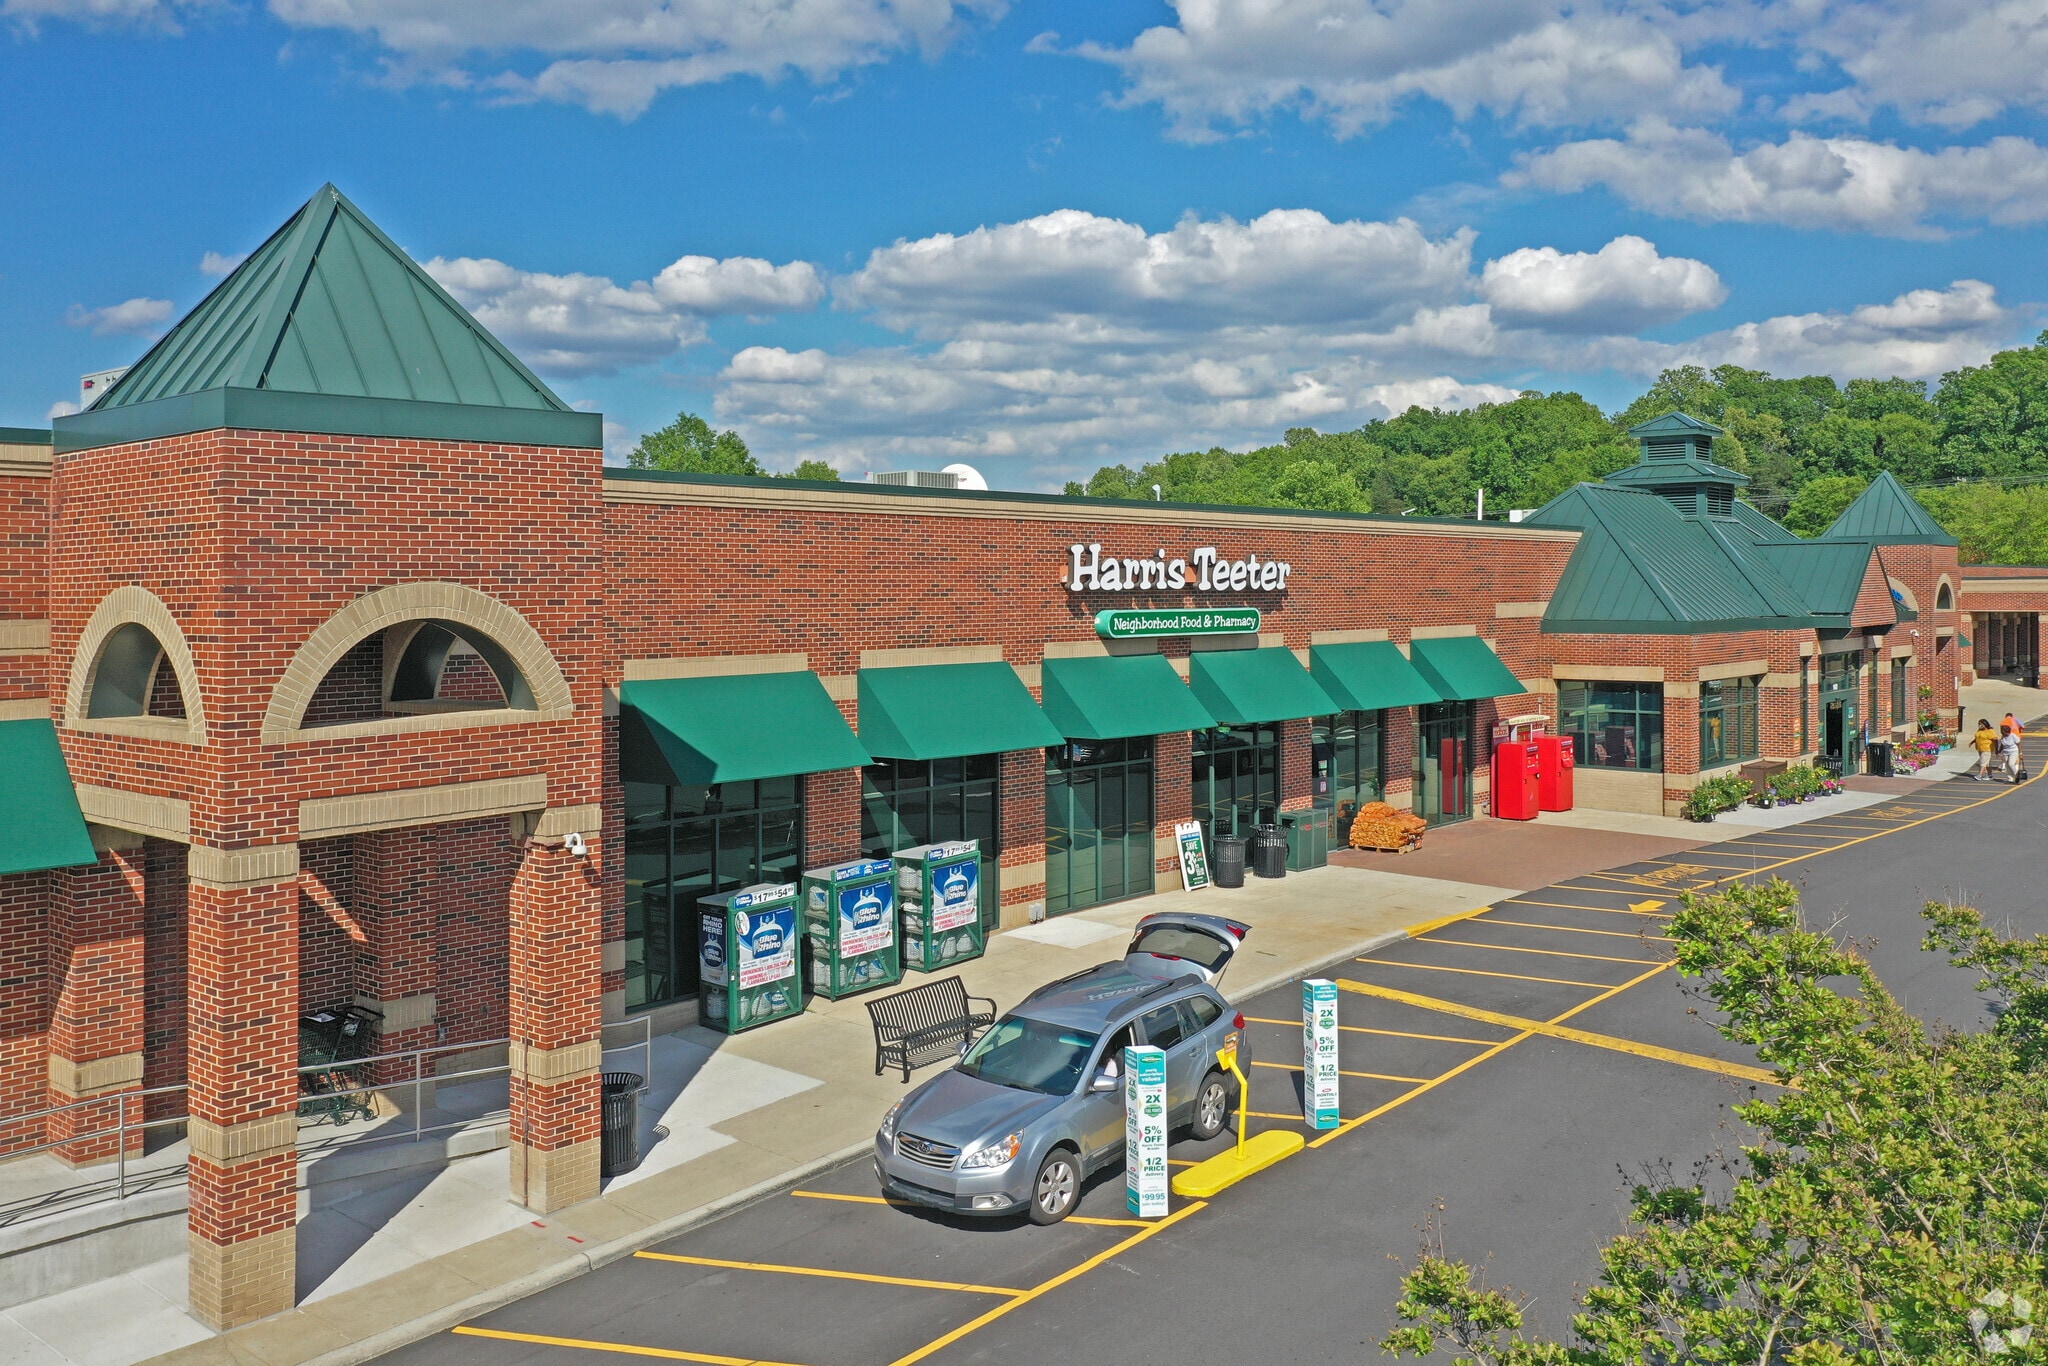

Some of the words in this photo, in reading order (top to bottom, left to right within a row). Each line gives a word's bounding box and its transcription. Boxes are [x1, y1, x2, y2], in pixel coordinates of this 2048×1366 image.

[1070, 543, 1186, 592] Harris
[1192, 546, 1291, 592] Teeter
[1113, 616, 1179, 634] Neighborhood
[1180, 615, 1203, 629] Food
[1203, 614, 1213, 628] &
[1213, 614, 1257, 630] Pharmacy
[1185, 840, 1198, 851] SAVE
[859, 906, 877, 916] Blue
[702, 919, 723, 928] RHINO
[702, 925, 723, 936] HERE!
[760, 934, 778, 943] Blue
[1320, 1009, 1334, 1017] 2X
[1319, 1036, 1335, 1045] 5%
[1320, 1063, 1335, 1072] 1/2
[1145, 1094, 1161, 1104] 2X
[1144, 1124, 1162, 1135] 5%
[1143, 1135, 1163, 1144] OFF
[1145, 1157, 1162, 1166] 1/2
